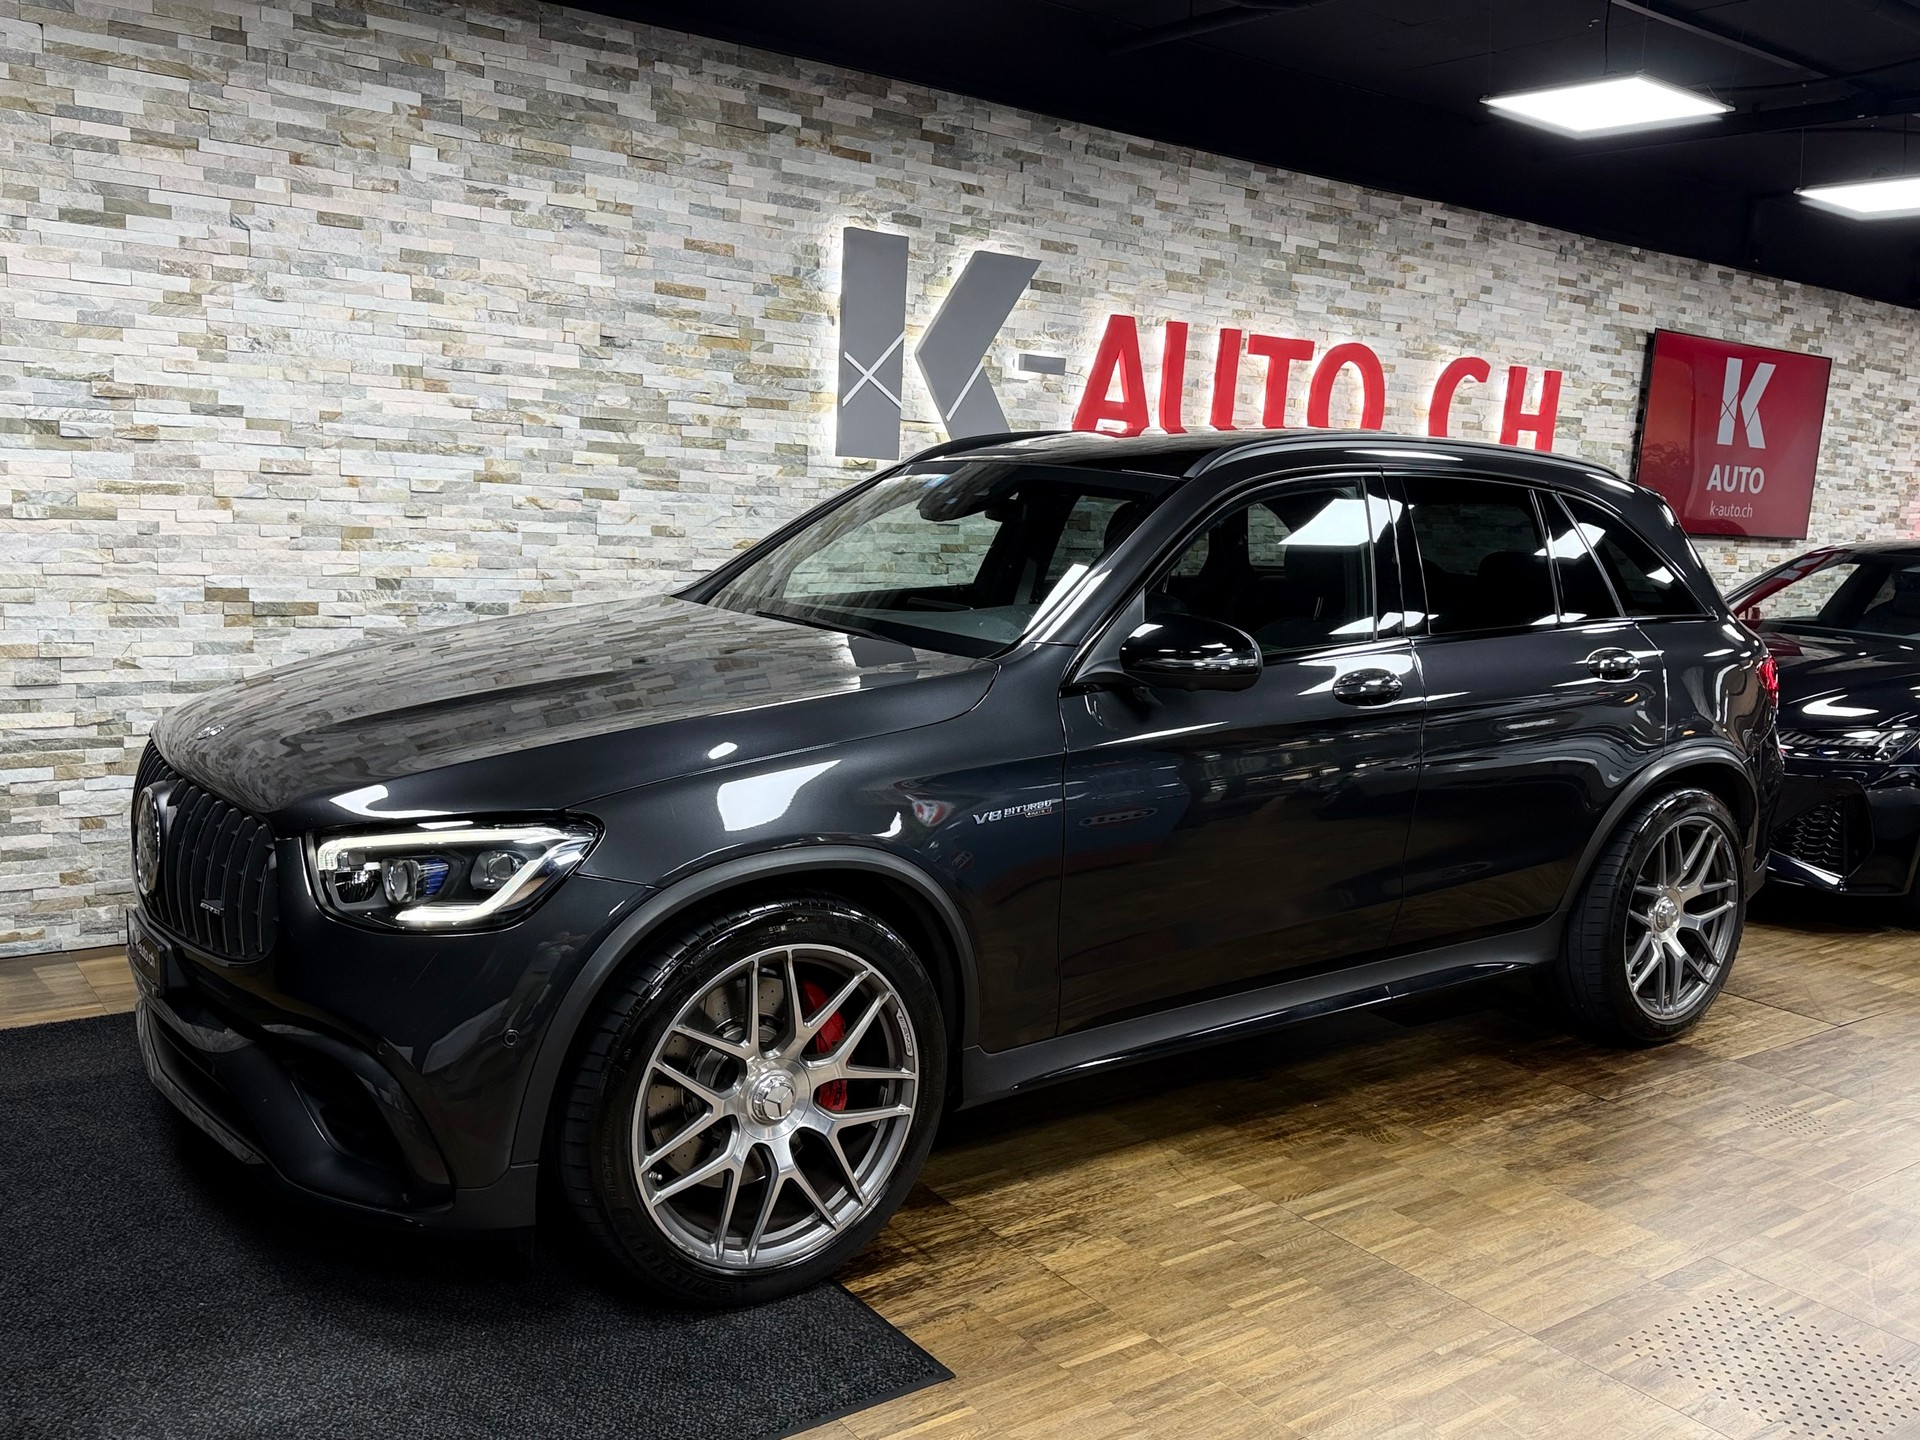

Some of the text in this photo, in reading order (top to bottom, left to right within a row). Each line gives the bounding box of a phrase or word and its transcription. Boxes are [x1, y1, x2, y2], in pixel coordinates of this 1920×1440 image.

[1717, 357, 1777, 449] K
[1706, 464, 1765, 494] AUTO
[1709, 500, 1754, 518] k-auto.ch
[973, 810, 1003, 825] V8
[1003, 800, 1052, 816] BITURBO
